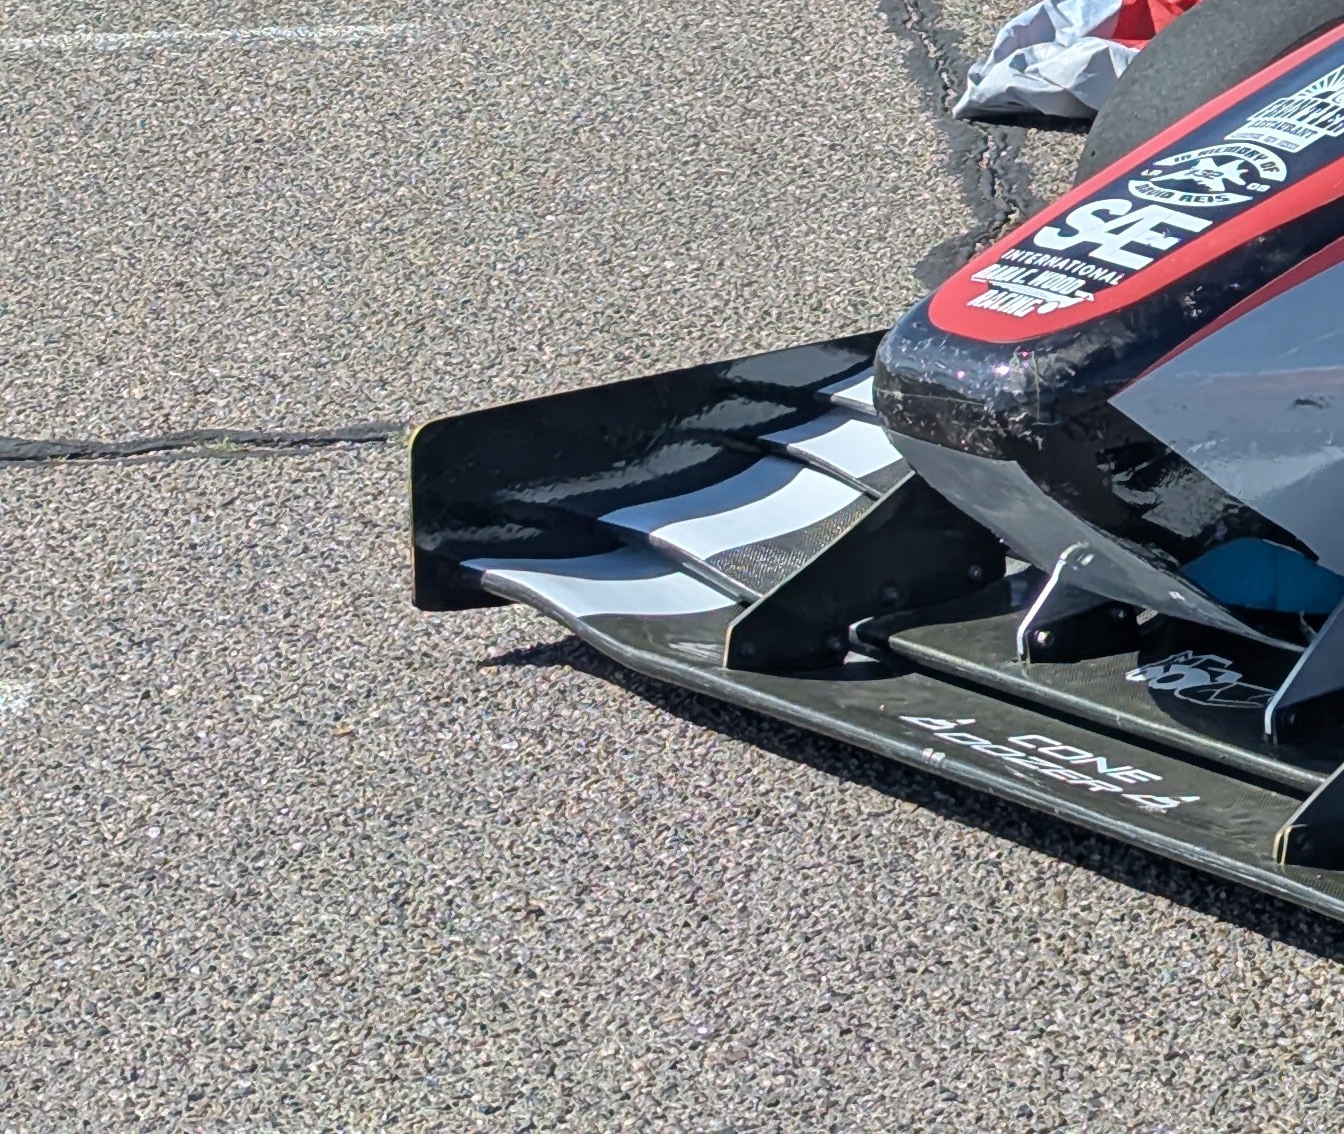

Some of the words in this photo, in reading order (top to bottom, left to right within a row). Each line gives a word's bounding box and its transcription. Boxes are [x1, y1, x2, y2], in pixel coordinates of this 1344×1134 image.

[1033, 198, 1213, 271] SAE
[1000, 248, 1125, 286] INTERNATIONAL
[1027, 270, 1087, 295] WOOD
[966, 289, 1046, 317] RACING
[934, 732, 1124, 794] DOZER
[1009, 733, 1164, 784] CONE
